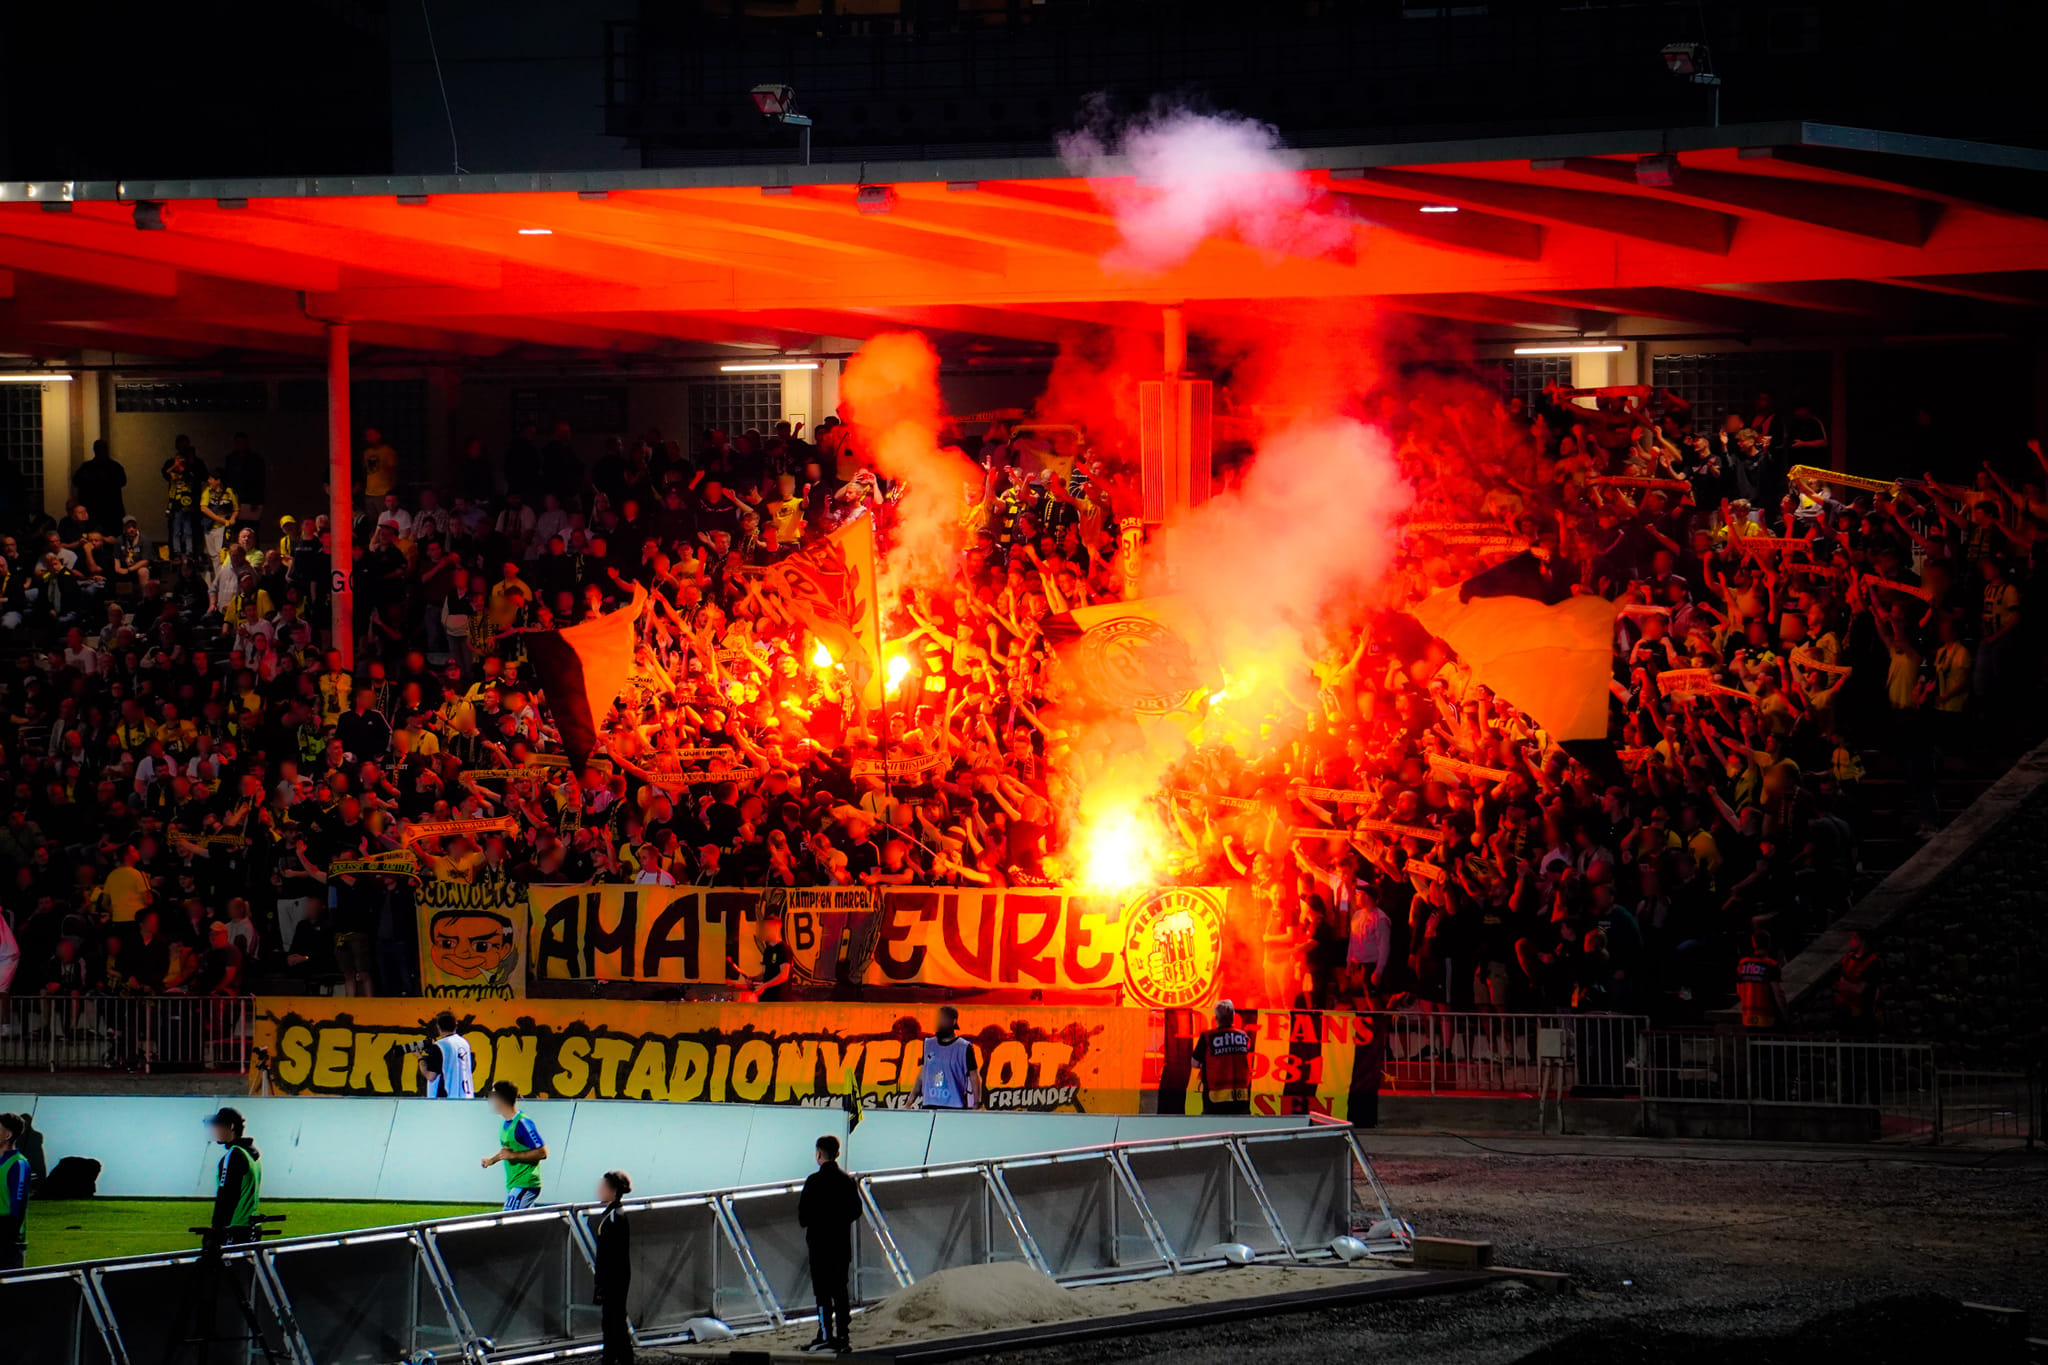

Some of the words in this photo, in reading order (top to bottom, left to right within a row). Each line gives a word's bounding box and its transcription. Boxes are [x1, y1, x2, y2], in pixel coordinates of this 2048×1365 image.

[649, 772, 690, 783] ORUSSIA
[1212, 1032, 1248, 1048] atlas
[279, 1025, 539, 1097] SEKTON
[1249, 1051, 1324, 1084] 981
[989, 1086, 1077, 1109] FREUNDE!
[1253, 1093, 1335, 1116] SEN
